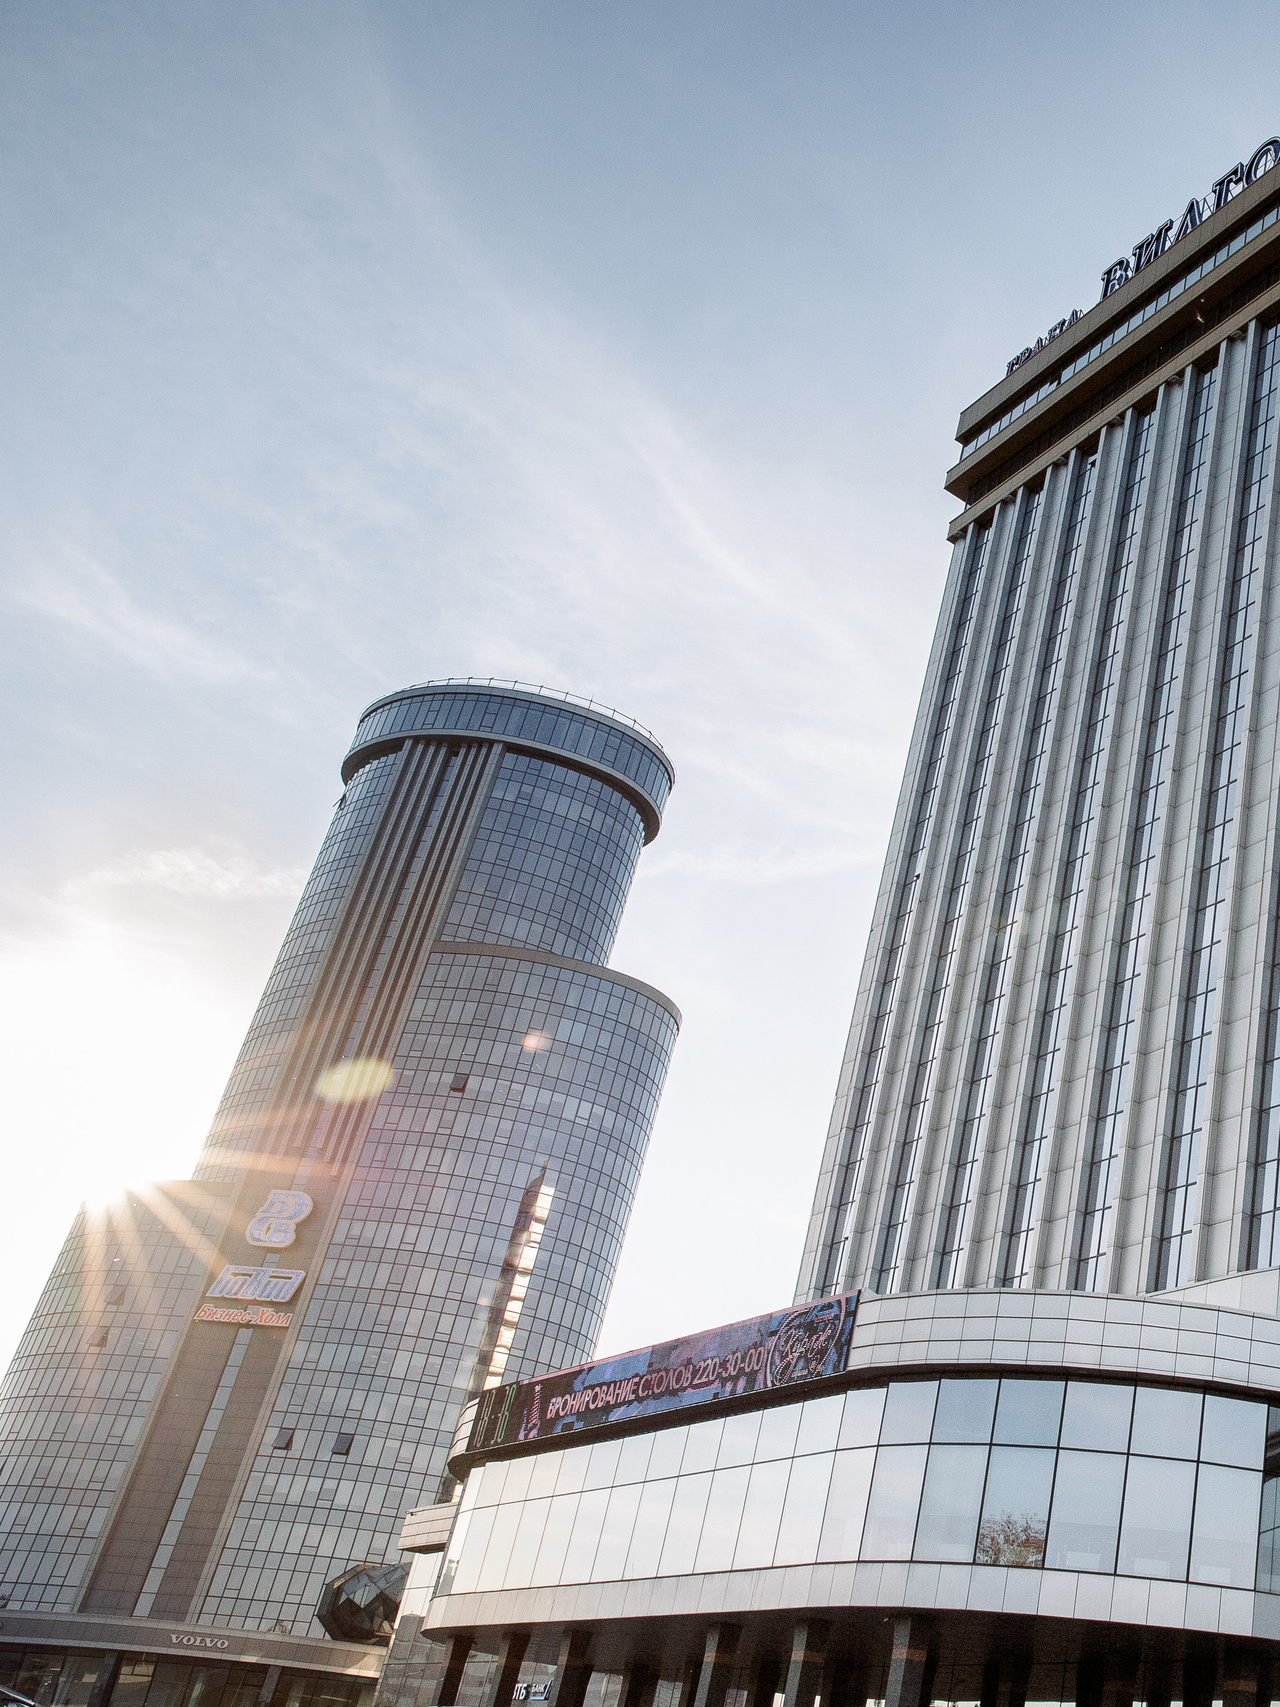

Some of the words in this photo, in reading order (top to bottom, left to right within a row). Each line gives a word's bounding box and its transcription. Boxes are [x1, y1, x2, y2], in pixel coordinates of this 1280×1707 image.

[195, 1304, 292, 1326] Бизнес-Холл
[546, 1376, 638, 1420] БРОНИРОВАНИЕ
[638, 1363, 692, 1397] СТОЛОВ
[693, 1346, 765, 1384] 220-30-00
[170, 1634, 229, 1649] VOLVO
[531, 1683, 546, 1693] БАНК
